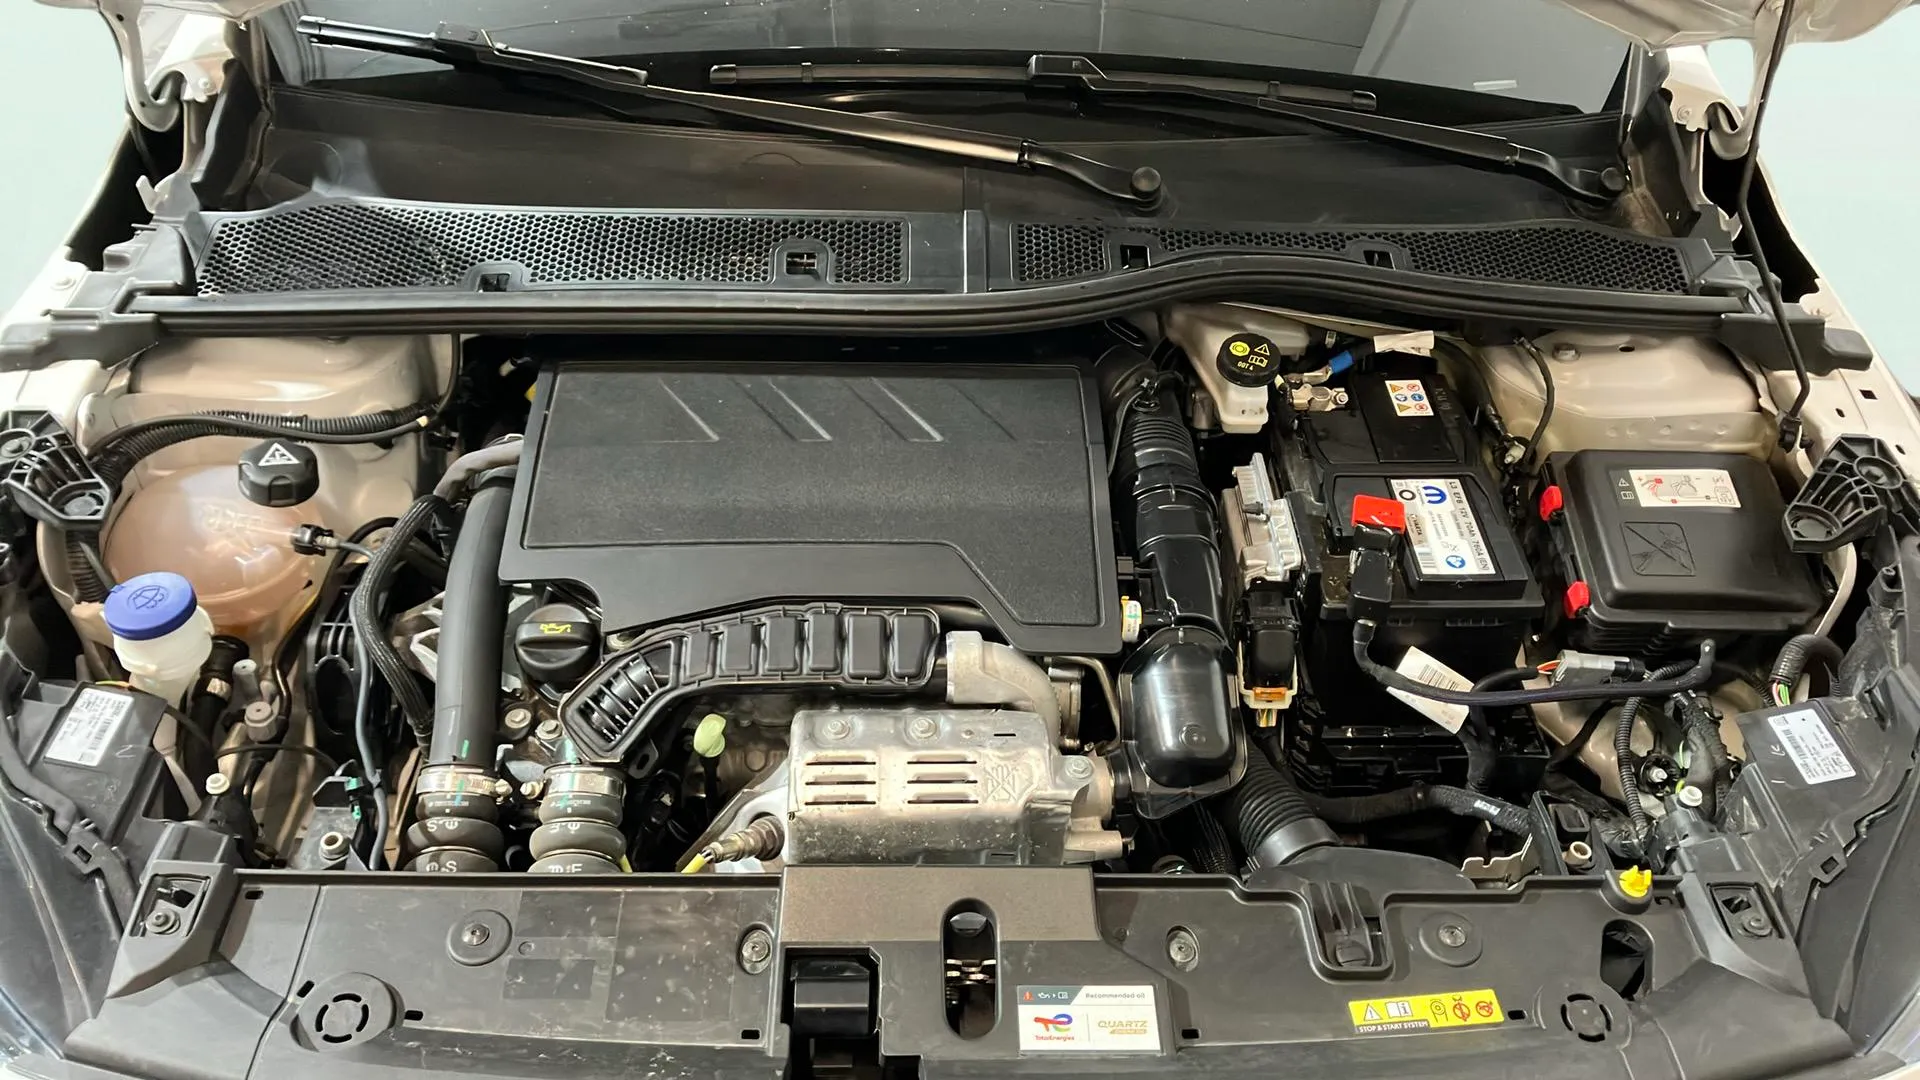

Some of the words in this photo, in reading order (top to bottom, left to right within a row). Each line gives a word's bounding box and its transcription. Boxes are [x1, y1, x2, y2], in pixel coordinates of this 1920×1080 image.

[1237, 361, 1249, 369] DOT
[1413, 519, 1422, 535] VARTA
[1459, 507, 1468, 517] 12V
[1478, 557, 1490, 570] (EN)
[1098, 1020, 1148, 1029] QUARTZ
[1383, 1023, 1402, 1031] START
[1035, 1034, 1075, 1042] TotalEnergies
